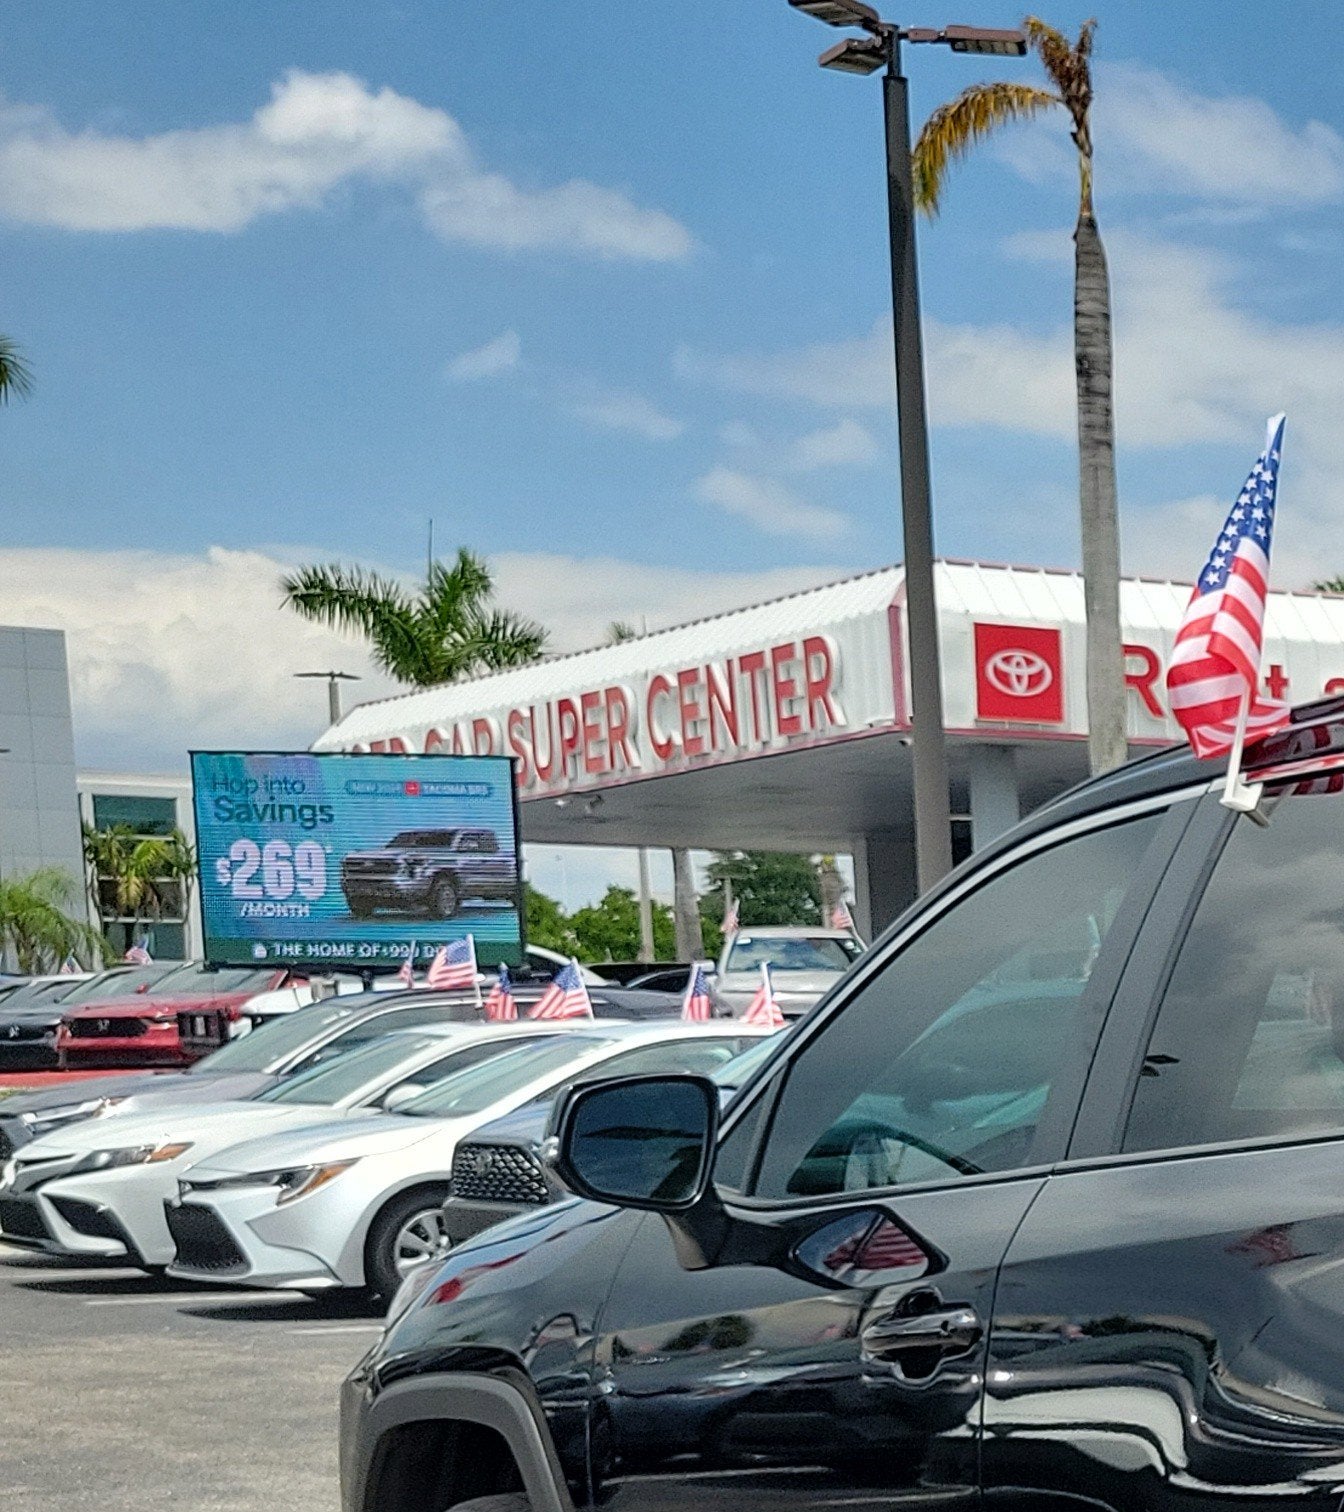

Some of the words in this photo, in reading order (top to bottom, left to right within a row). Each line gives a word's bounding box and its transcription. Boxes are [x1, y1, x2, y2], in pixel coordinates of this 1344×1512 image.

[507, 686, 638, 788] SUPER
[647, 636, 843, 762] CENTER
[212, 774, 258, 795] Hop
[264, 774, 305, 794] into
[214, 795, 334, 829] Savings
[273, 943, 303, 957] THE
[308, 943, 354, 957] HOME
